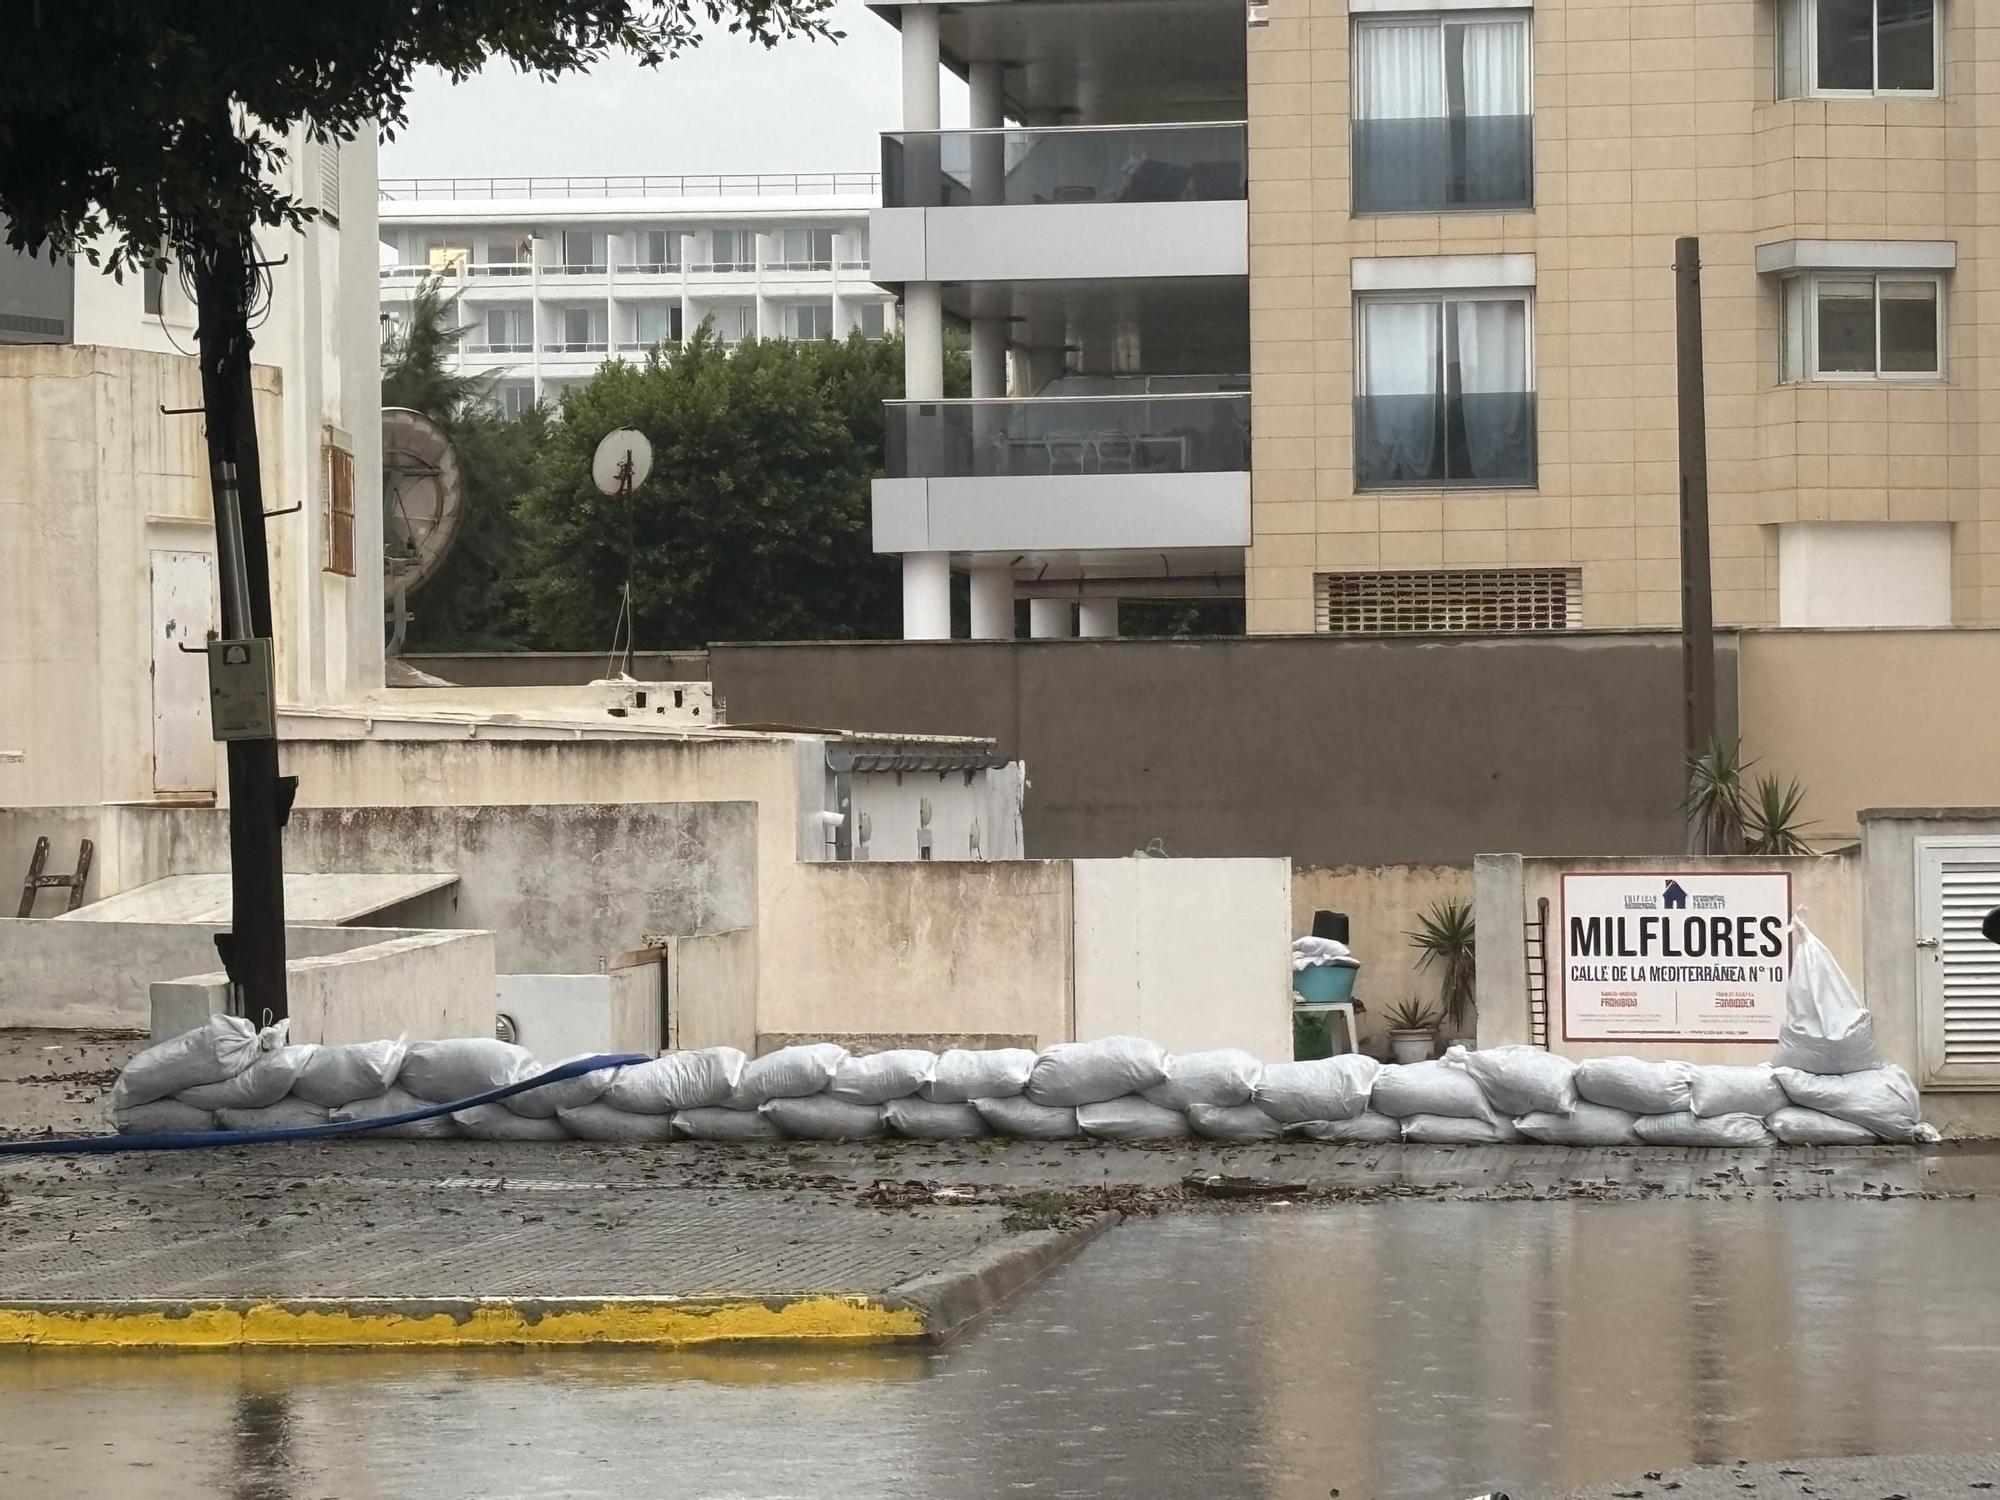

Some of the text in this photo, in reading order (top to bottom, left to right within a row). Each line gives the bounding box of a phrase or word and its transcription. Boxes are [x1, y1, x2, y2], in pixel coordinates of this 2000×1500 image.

[1570, 916, 1783, 957] MILFLORES
[1571, 965, 1609, 982] CALLE
[1611, 965, 1628, 981] DE
[1631, 966, 1646, 982] LA
[1768, 966, 1783, 982] 10
